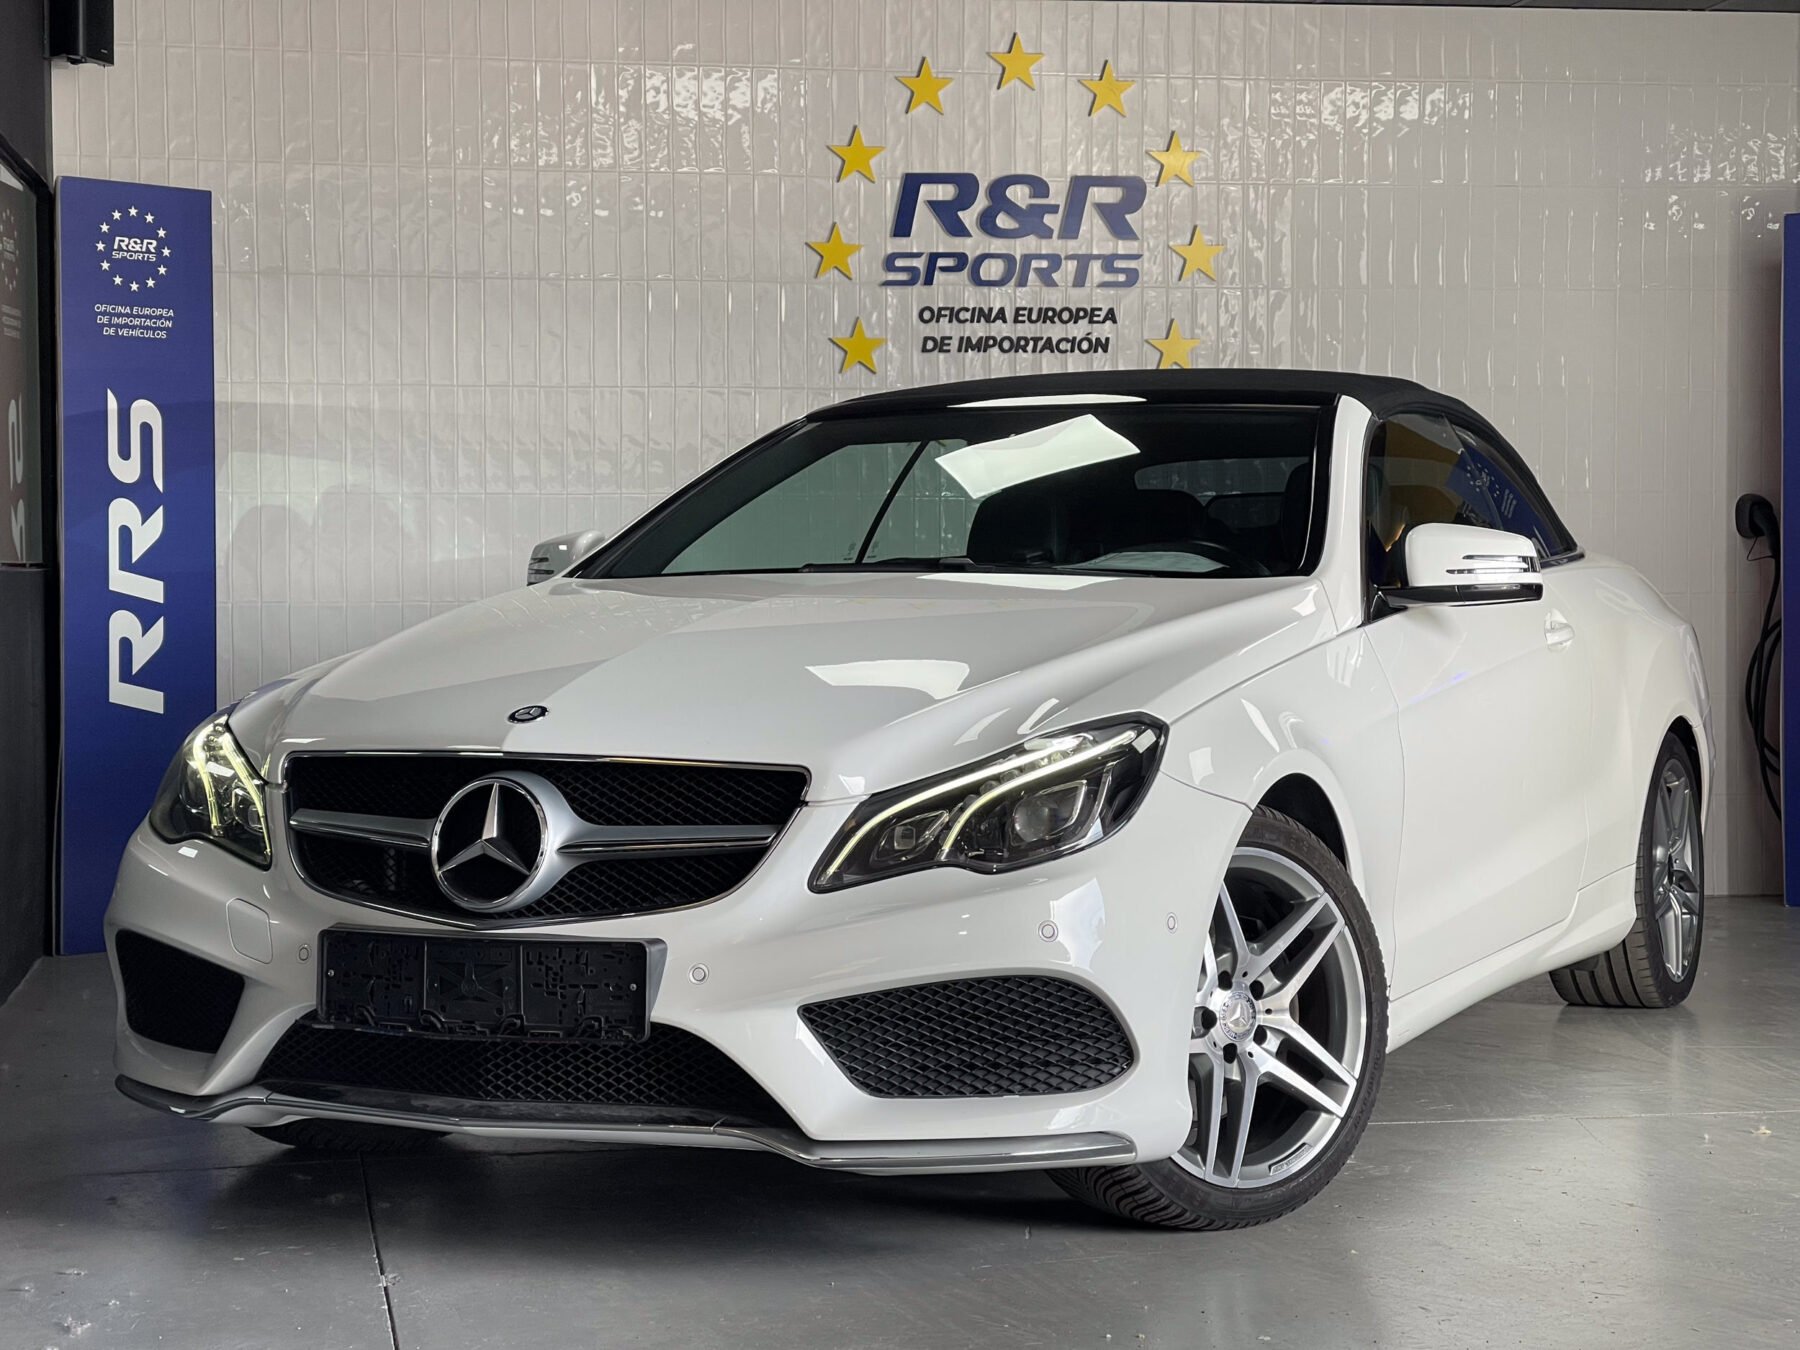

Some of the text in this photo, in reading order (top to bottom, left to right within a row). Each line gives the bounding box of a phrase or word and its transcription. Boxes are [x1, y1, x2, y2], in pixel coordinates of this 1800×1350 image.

[890, 172, 1147, 241] R&R
[113, 236, 158, 253] R&R
[111, 250, 157, 262] SPORTS
[881, 252, 1145, 289] SPORTS
[94, 303, 174, 317] OFICINA EUROPEA
[918, 305, 1118, 325] OFICINA EUROPEA
[96, 315, 173, 328] DE IMPORTACIÓN
[103, 327, 167, 339] DE VEHÍCULOS
[921, 331, 1110, 355] DE IMPORTACIÓN
[107, 388, 164, 714] RRS
